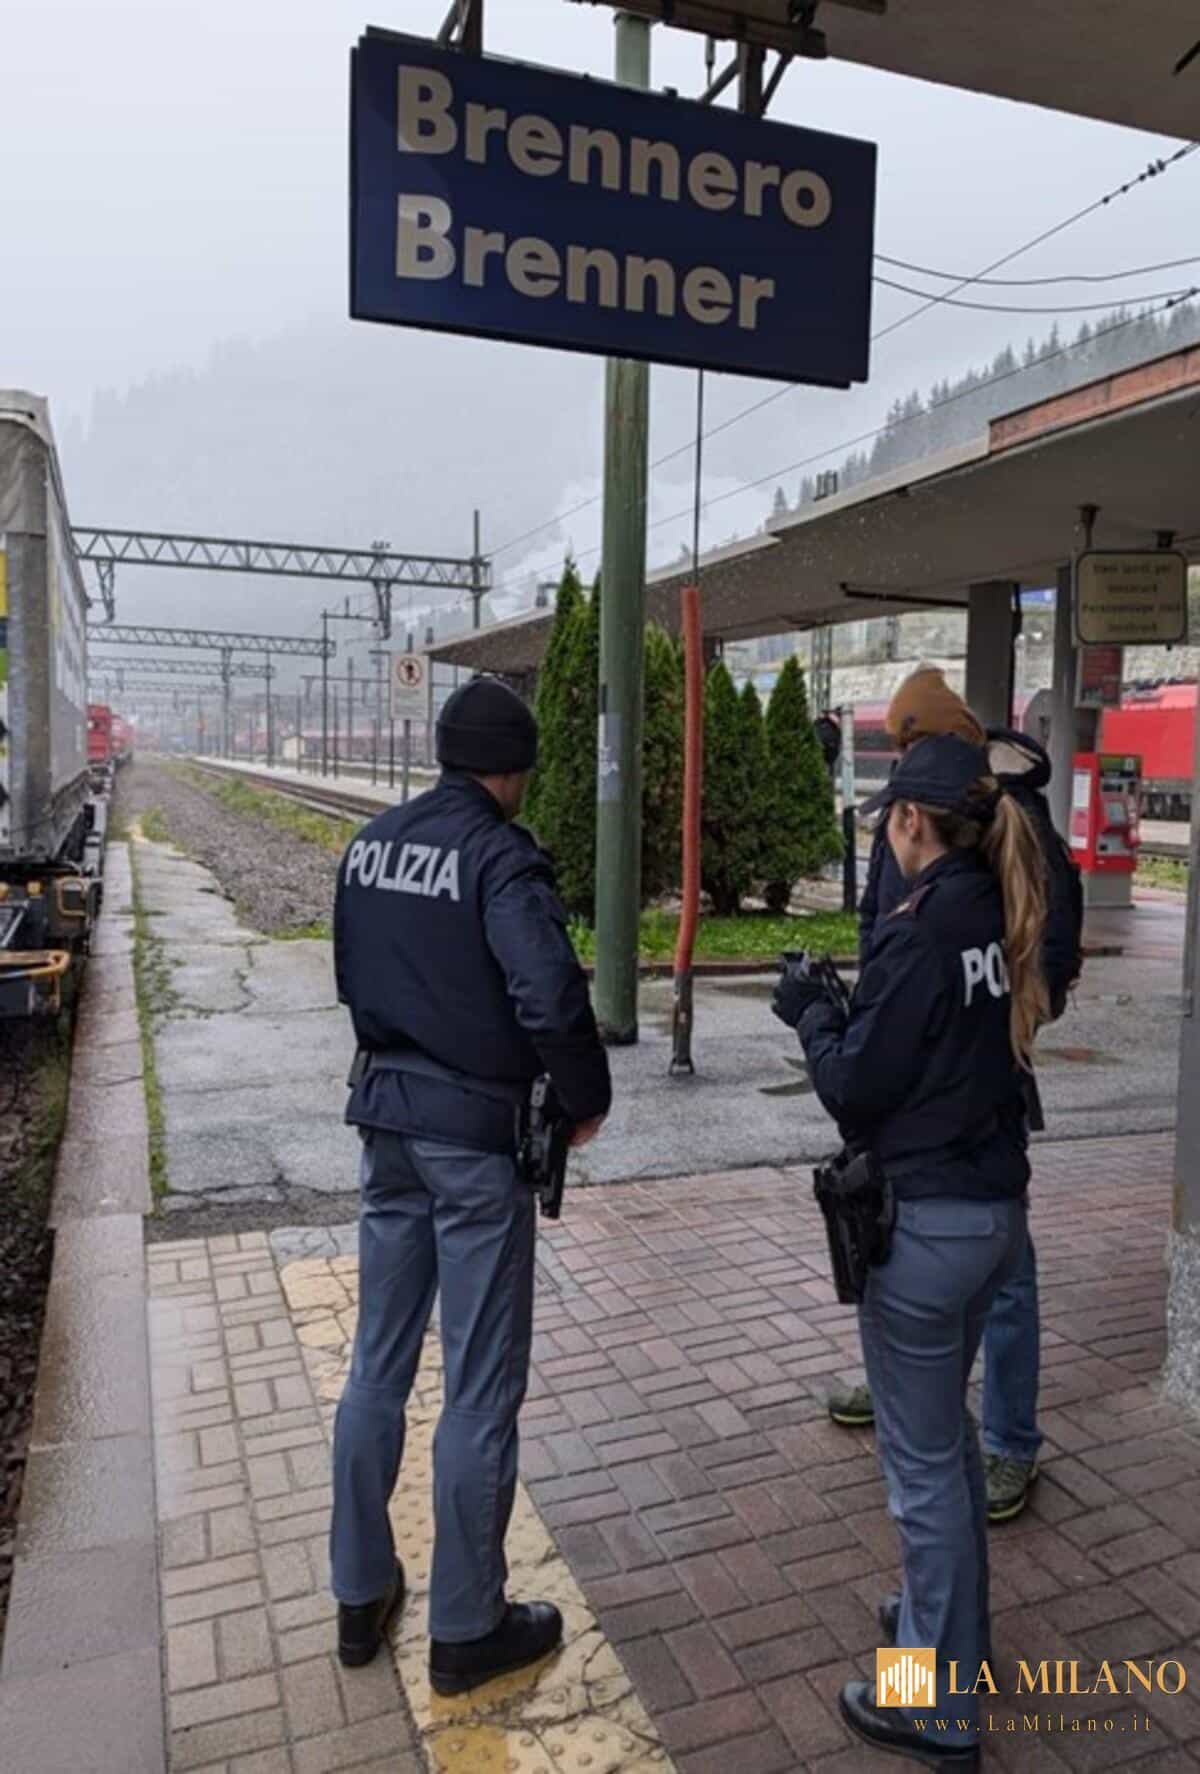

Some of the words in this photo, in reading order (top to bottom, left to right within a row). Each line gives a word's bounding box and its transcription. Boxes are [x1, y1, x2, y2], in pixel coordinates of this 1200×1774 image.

[397, 66, 833, 228] Brennero
[396, 194, 775, 330] Brenner
[345, 839, 460, 901] POLIZIA
[960, 941, 1011, 1007] PO
